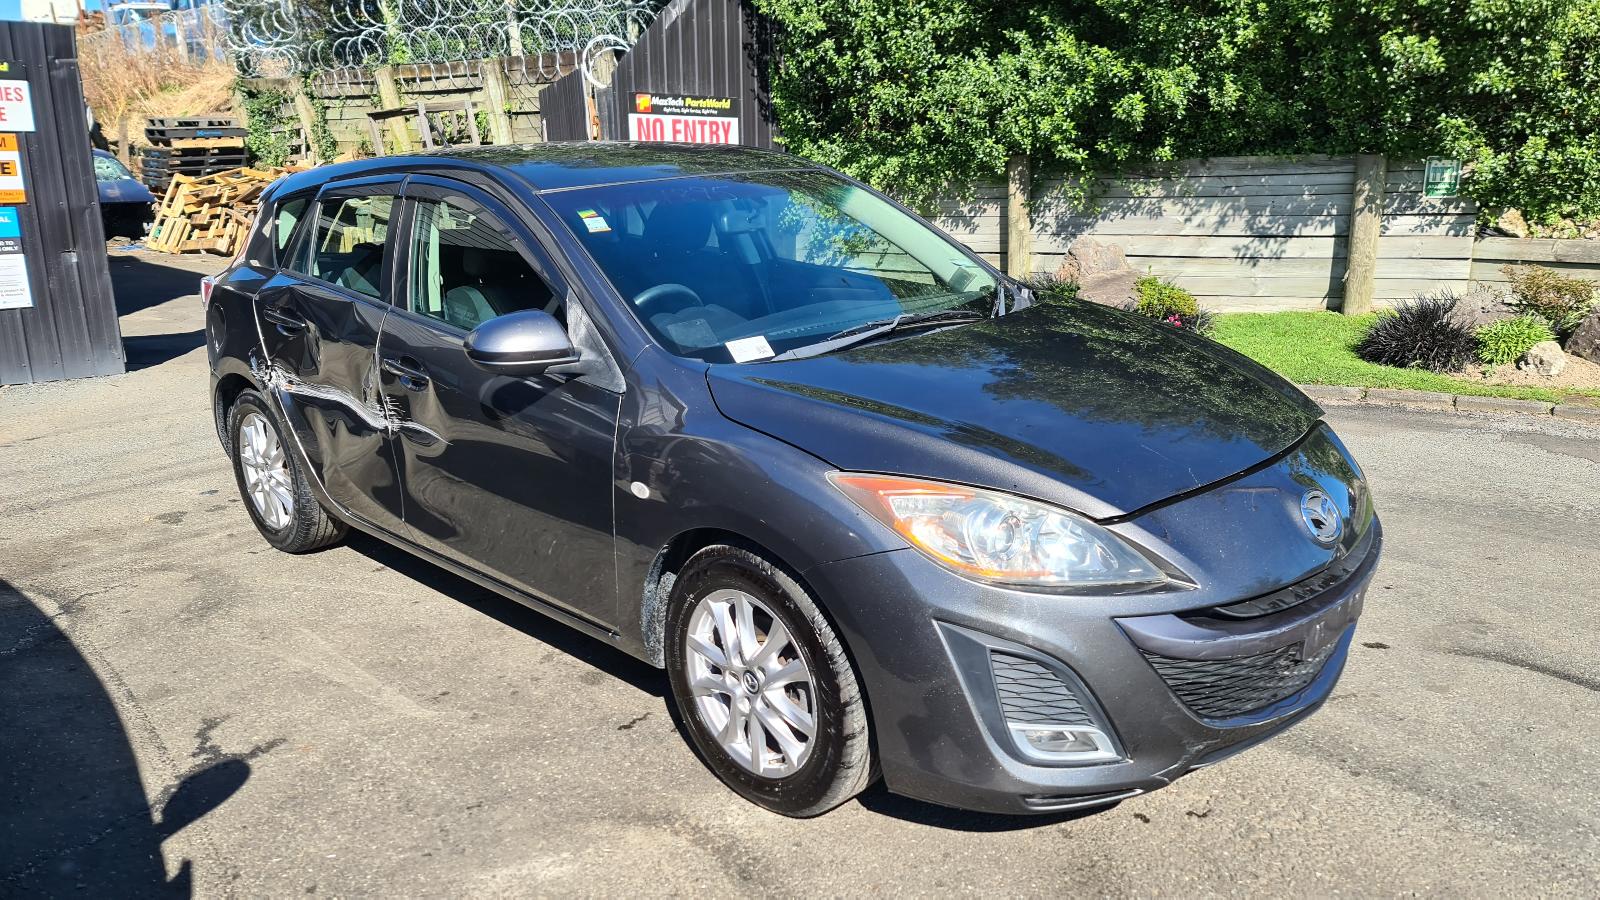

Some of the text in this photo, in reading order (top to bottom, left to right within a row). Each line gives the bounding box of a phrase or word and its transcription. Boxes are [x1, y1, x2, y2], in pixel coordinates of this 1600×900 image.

[651, 96, 731, 109] MaxTech PartsWorld
[636, 117, 731, 144] NO ENTRY
